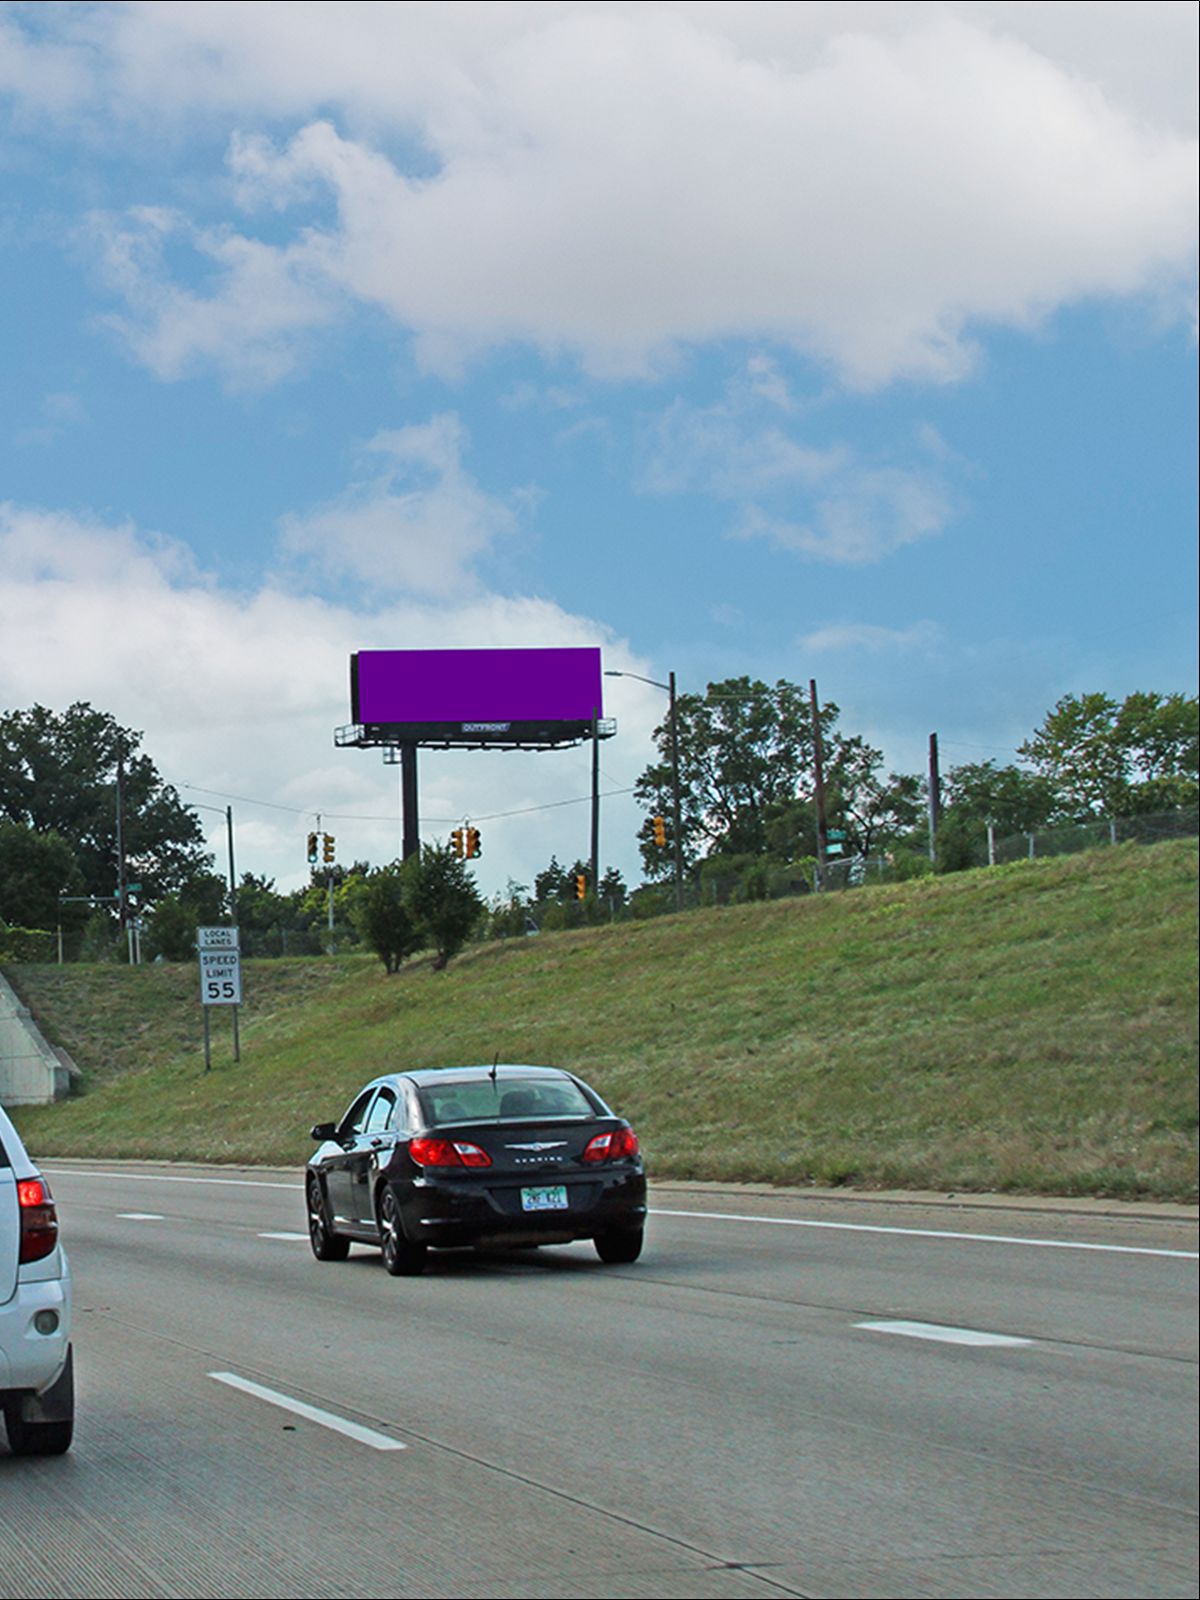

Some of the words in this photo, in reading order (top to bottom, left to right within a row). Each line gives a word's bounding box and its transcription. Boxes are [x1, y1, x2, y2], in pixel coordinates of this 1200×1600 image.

[204, 930, 232, 938] LOCAL
[202, 955, 237, 966] SPEED
[206, 969, 233, 978] LIMIT
[208, 982, 234, 999] 55
